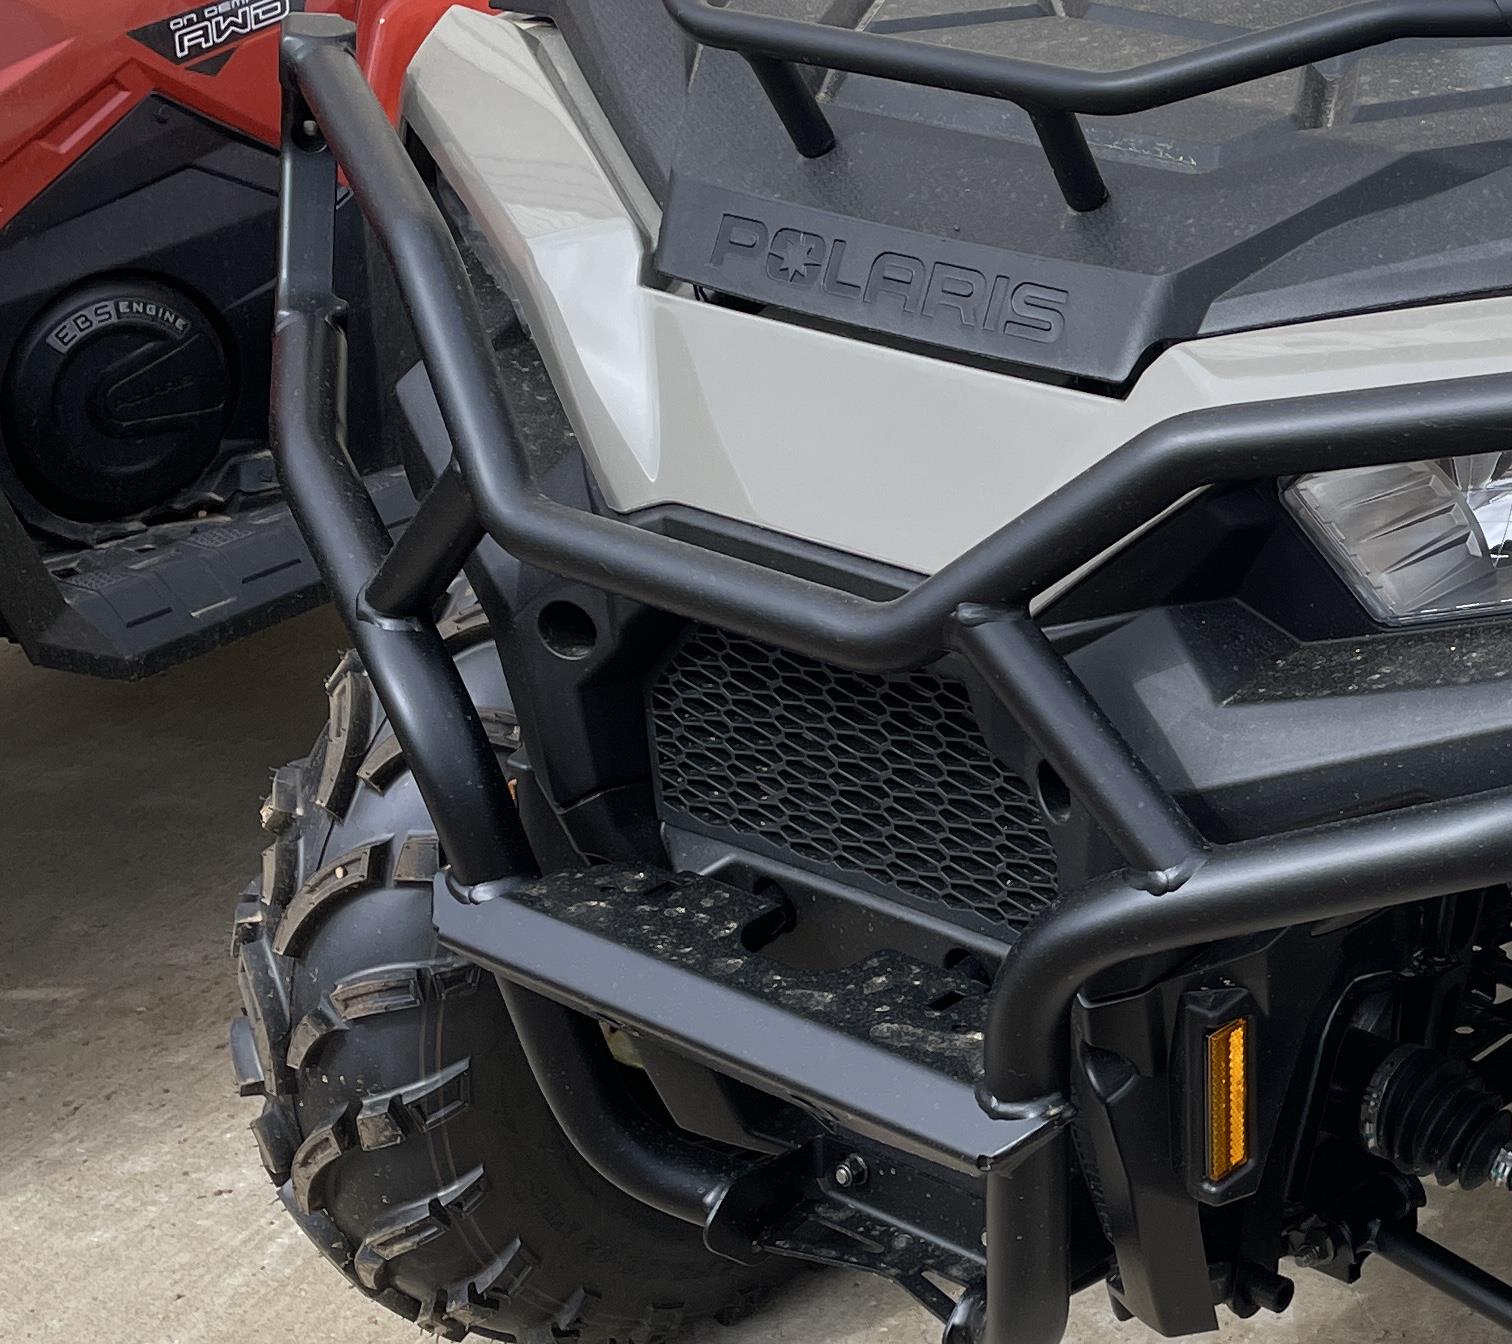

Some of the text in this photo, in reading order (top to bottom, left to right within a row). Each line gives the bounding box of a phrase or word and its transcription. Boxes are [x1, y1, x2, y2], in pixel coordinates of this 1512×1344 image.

[54, 301, 189, 347] EBS ENGINE
[709, 212, 1070, 346] POLARIS
